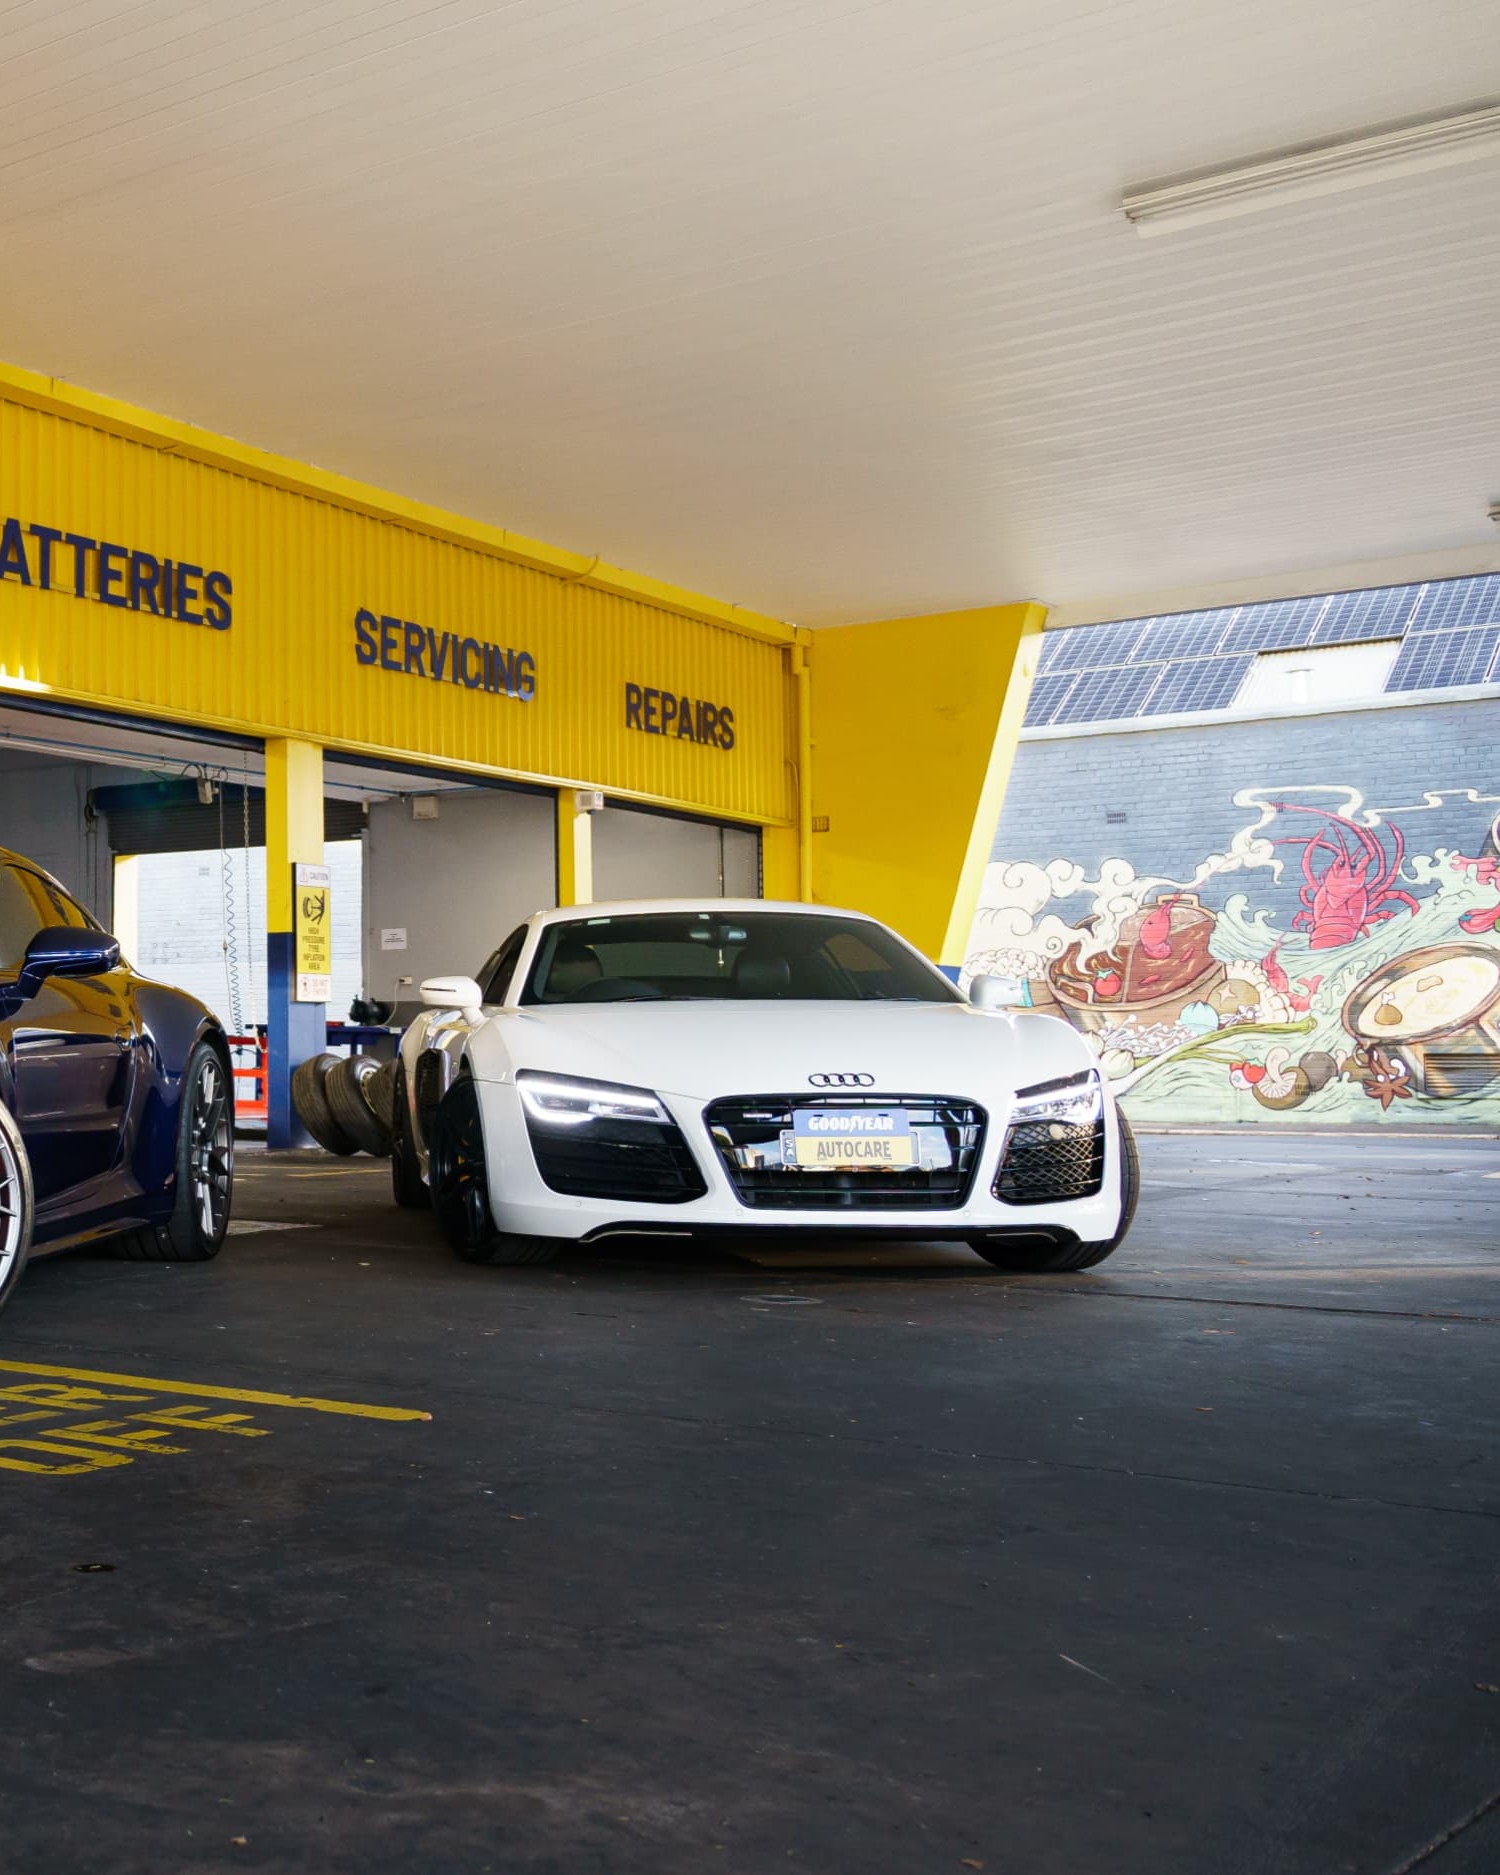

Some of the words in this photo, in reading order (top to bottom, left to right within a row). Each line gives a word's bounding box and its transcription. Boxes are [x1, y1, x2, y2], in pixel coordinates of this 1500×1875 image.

[354, 607, 536, 702] SERVICING
[626, 682, 735, 751] REPAIRS
[808, 1116, 893, 1132] GOODYEAR
[817, 1140, 892, 1159] AUTOCARE
